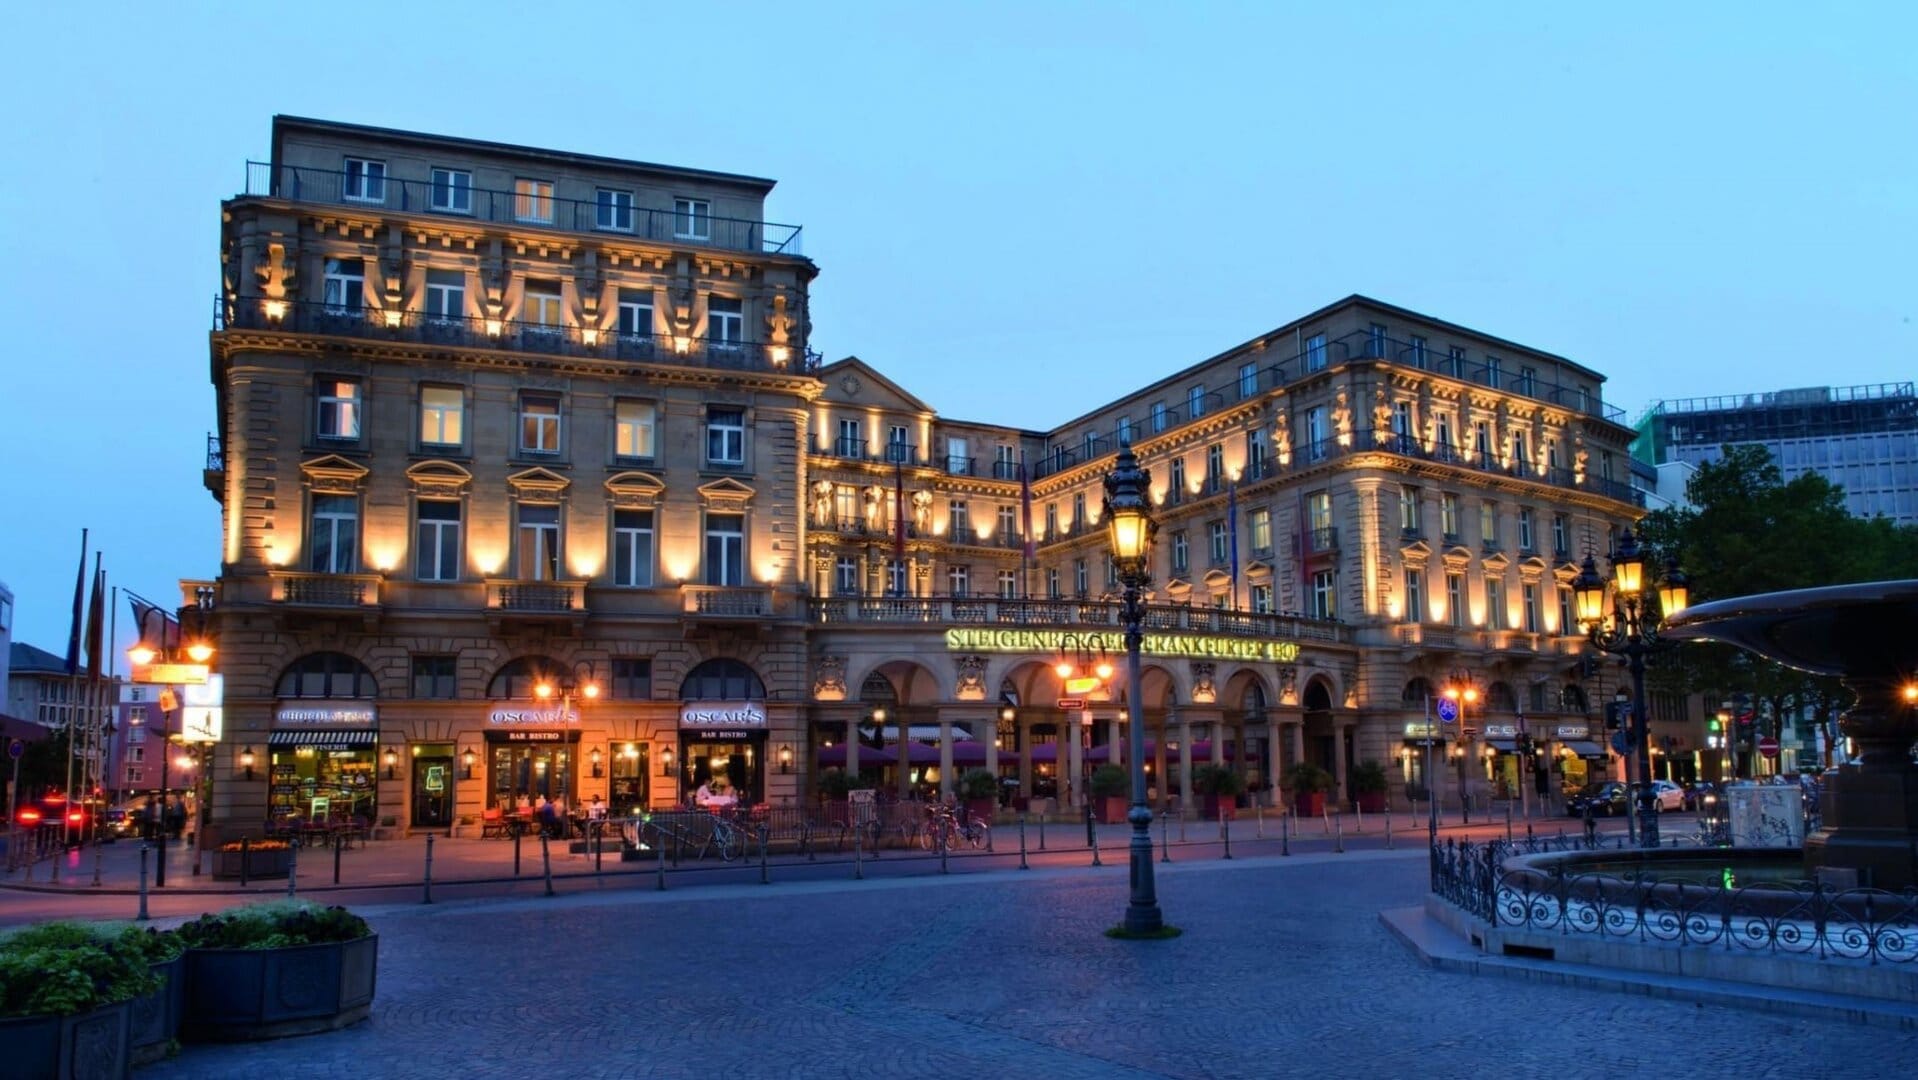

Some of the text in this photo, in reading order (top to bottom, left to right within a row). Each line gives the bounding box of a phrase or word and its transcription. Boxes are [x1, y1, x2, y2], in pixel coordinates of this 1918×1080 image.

[948, 630, 1300, 660] STEIGENBERGER FRANKFURTER HOF
[685, 706, 763, 723] OSCAR'S
[509, 732, 560, 740] BAR BISTRO
[701, 731, 747, 739] BAR BISTRO
